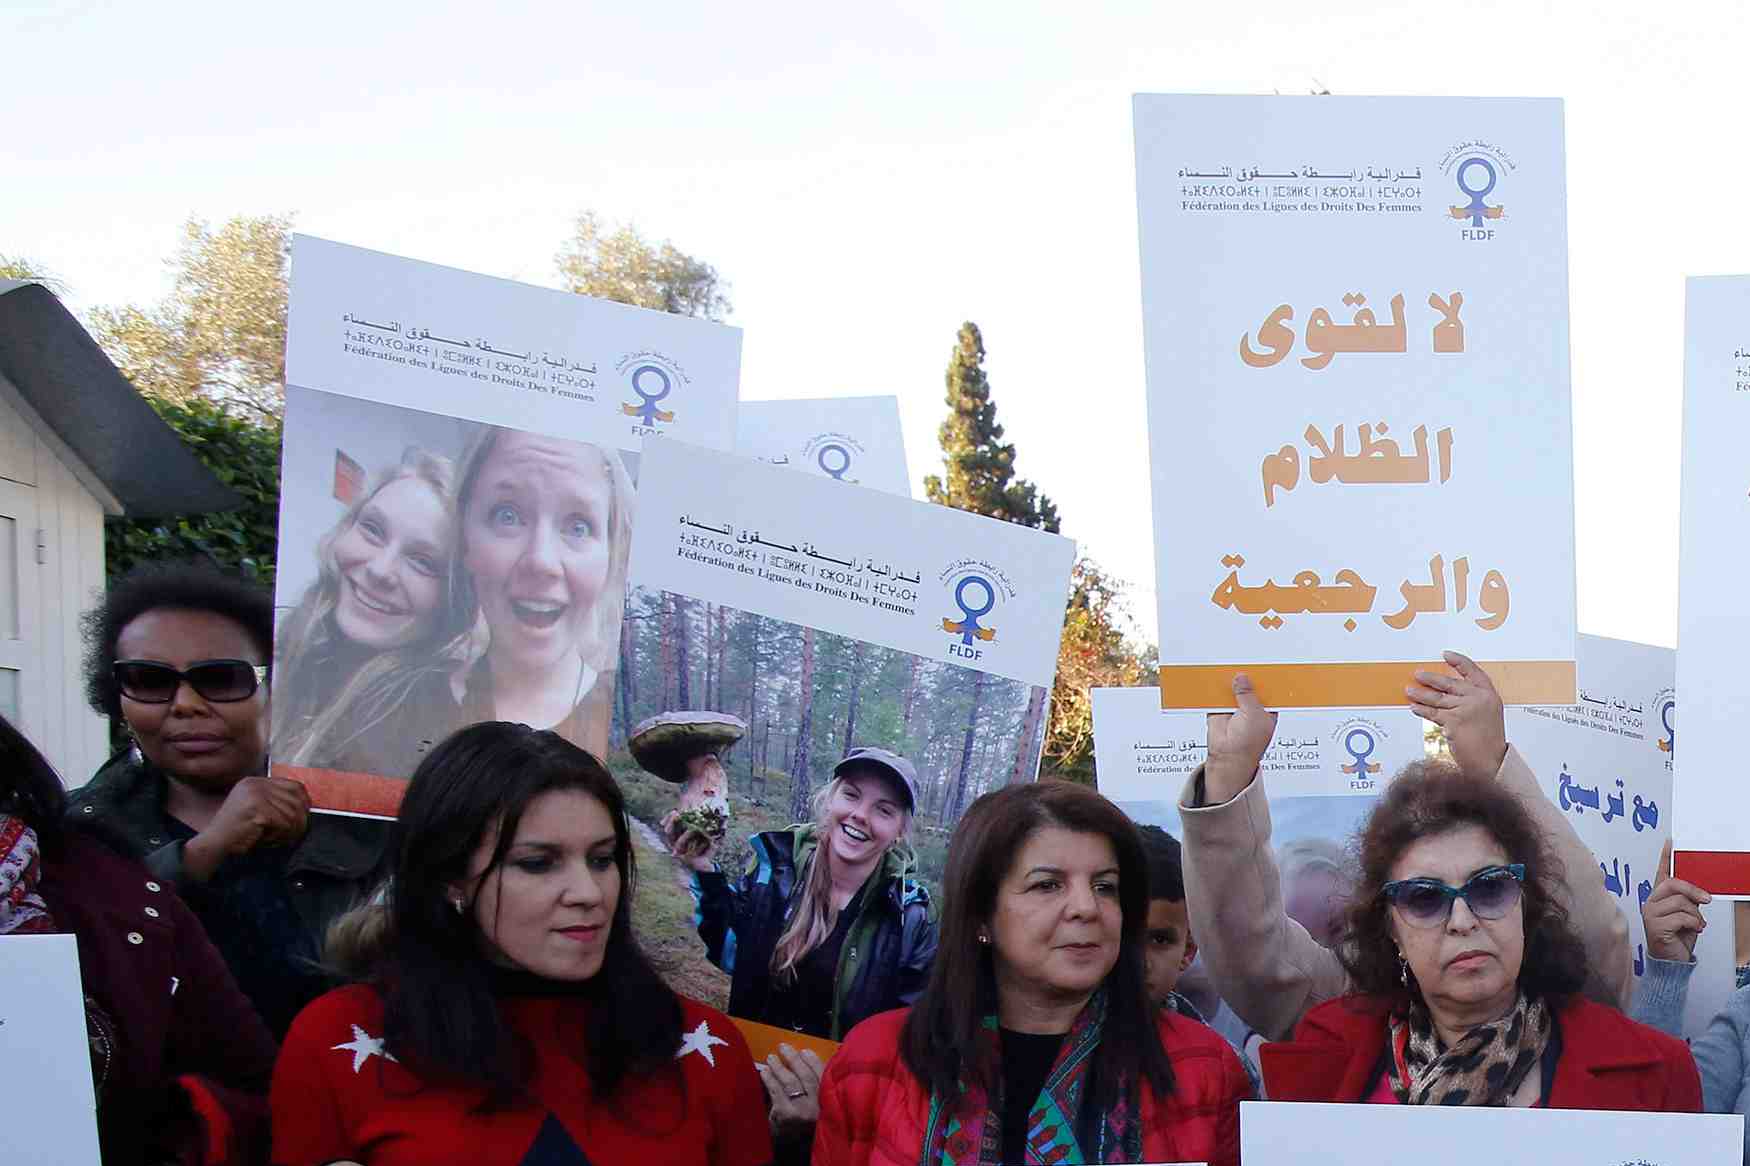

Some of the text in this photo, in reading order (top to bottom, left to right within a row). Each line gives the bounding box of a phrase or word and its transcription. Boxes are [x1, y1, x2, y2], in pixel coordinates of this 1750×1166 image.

[1182, 200, 1421, 213] Fédération des Ligues des Droits Des Femmes
[1461, 230, 1495, 240] FLDF
[1240, 292, 1464, 370] لا لقوى
[1262, 422, 1453, 508] الظلام
[678, 547, 914, 615] Fédération des Ligues des Droits Des Femmes
[1211, 554, 1509, 632] والرجعية
[949, 641, 982, 660] FLDF
